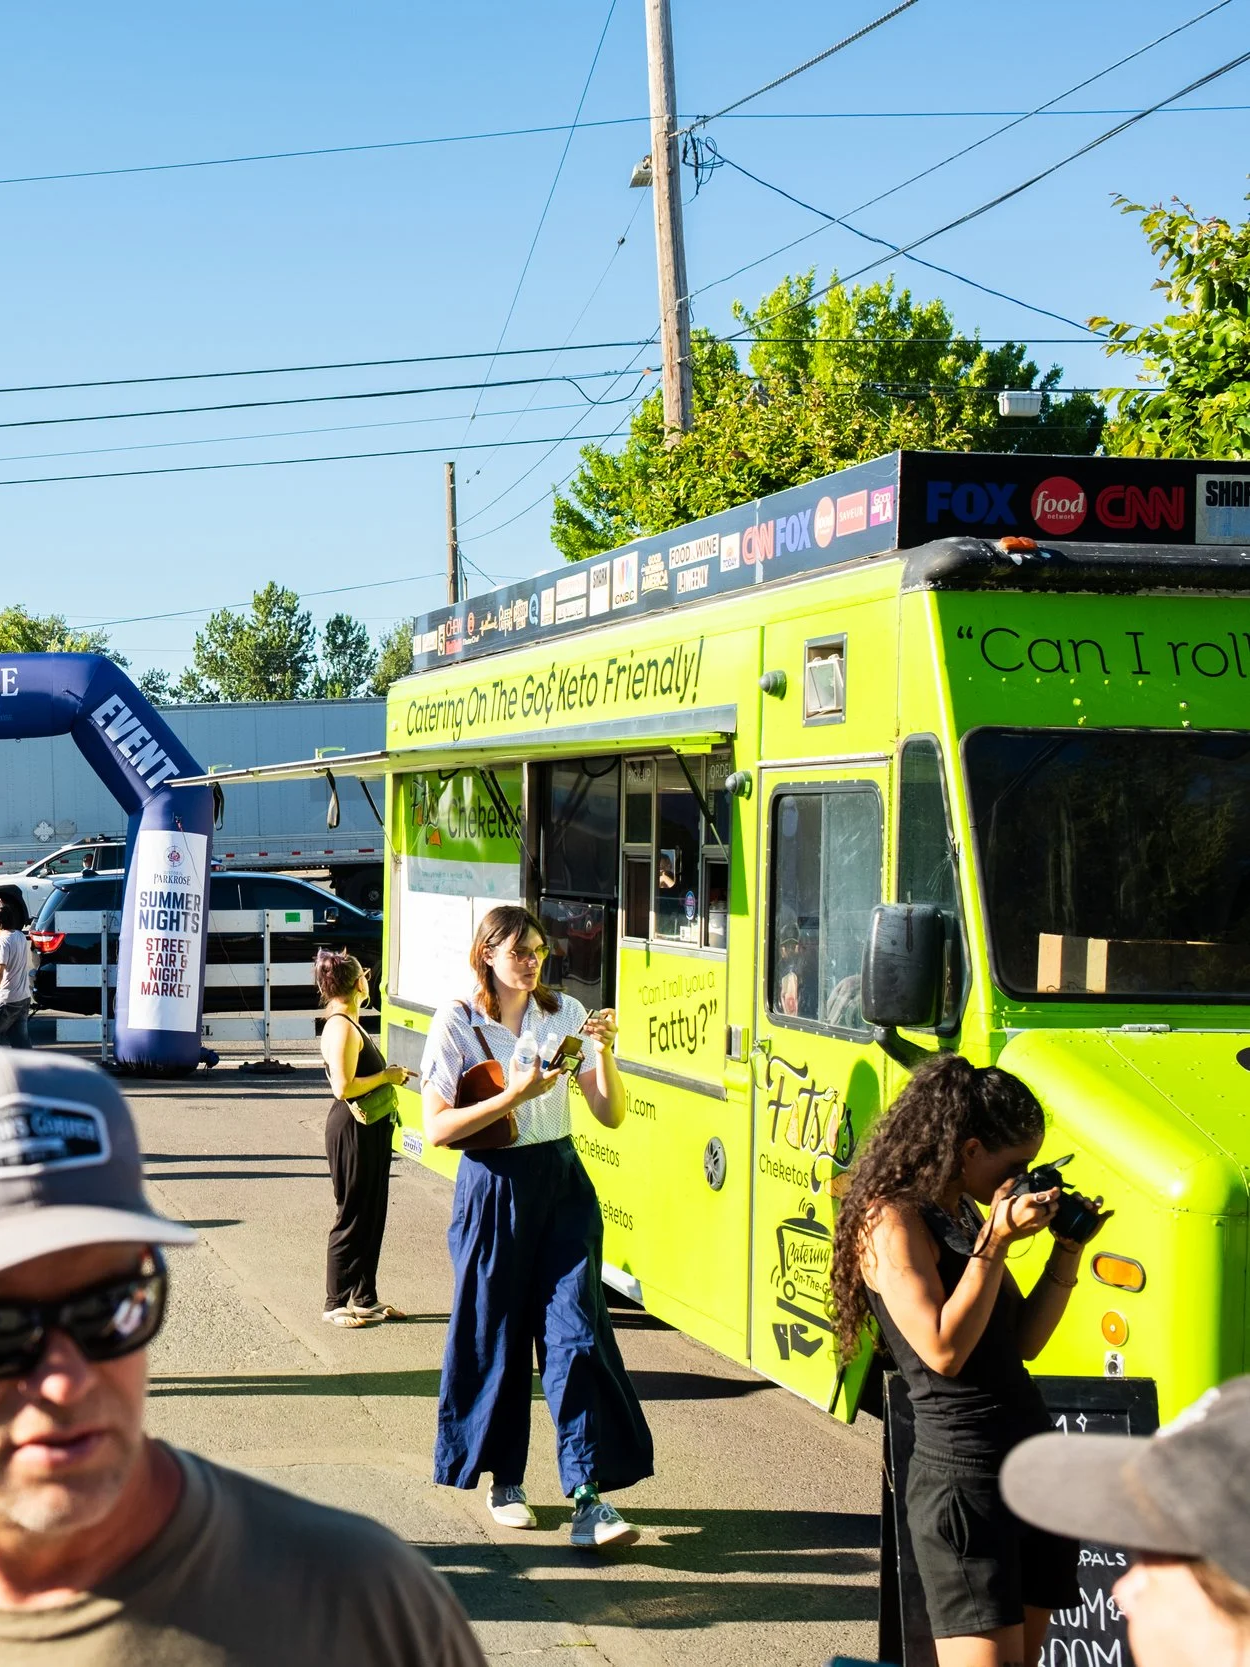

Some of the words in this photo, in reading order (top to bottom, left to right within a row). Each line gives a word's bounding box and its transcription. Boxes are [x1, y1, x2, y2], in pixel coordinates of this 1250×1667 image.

[839, 505, 864, 522] SAVEUR
[926, 480, 1018, 526] FOX
[1034, 490, 1086, 521] food
[1095, 484, 1185, 531] CNN
[742, 520, 774, 566] CNN
[776, 508, 812, 557] FOX
[670, 545, 690, 567] FOOD
[696, 537, 717, 558] WINE
[614, 590, 635, 605] CNBC
[1125, 631, 1151, 674] I
[407, 689, 464, 742] Catering
[467, 686, 487, 726] On
[491, 679, 518, 724] The
[558, 663, 598, 712] Keto
[603, 635, 705, 706] Friendly!
[91, 694, 180, 790] EVENT
[153, 873, 192, 886] PARKROSE
[139, 891, 201, 913] SUMMER
[138, 909, 200, 934] NIGHTS
[145, 937, 192, 955] STREET
[147, 951, 177, 968] FAIR
[180, 954, 188, 969] &
[149, 967, 185, 983] NIGHT
[669, 974, 683, 998] roll
[685, 974, 705, 998] you
[708, 971, 715, 988] a
[140, 981, 192, 999] MARKET
[759, 1153, 810, 1190] Cheketos
[786, 1241, 831, 1274] Catering
[1078, 1549, 1127, 1567] PALS
